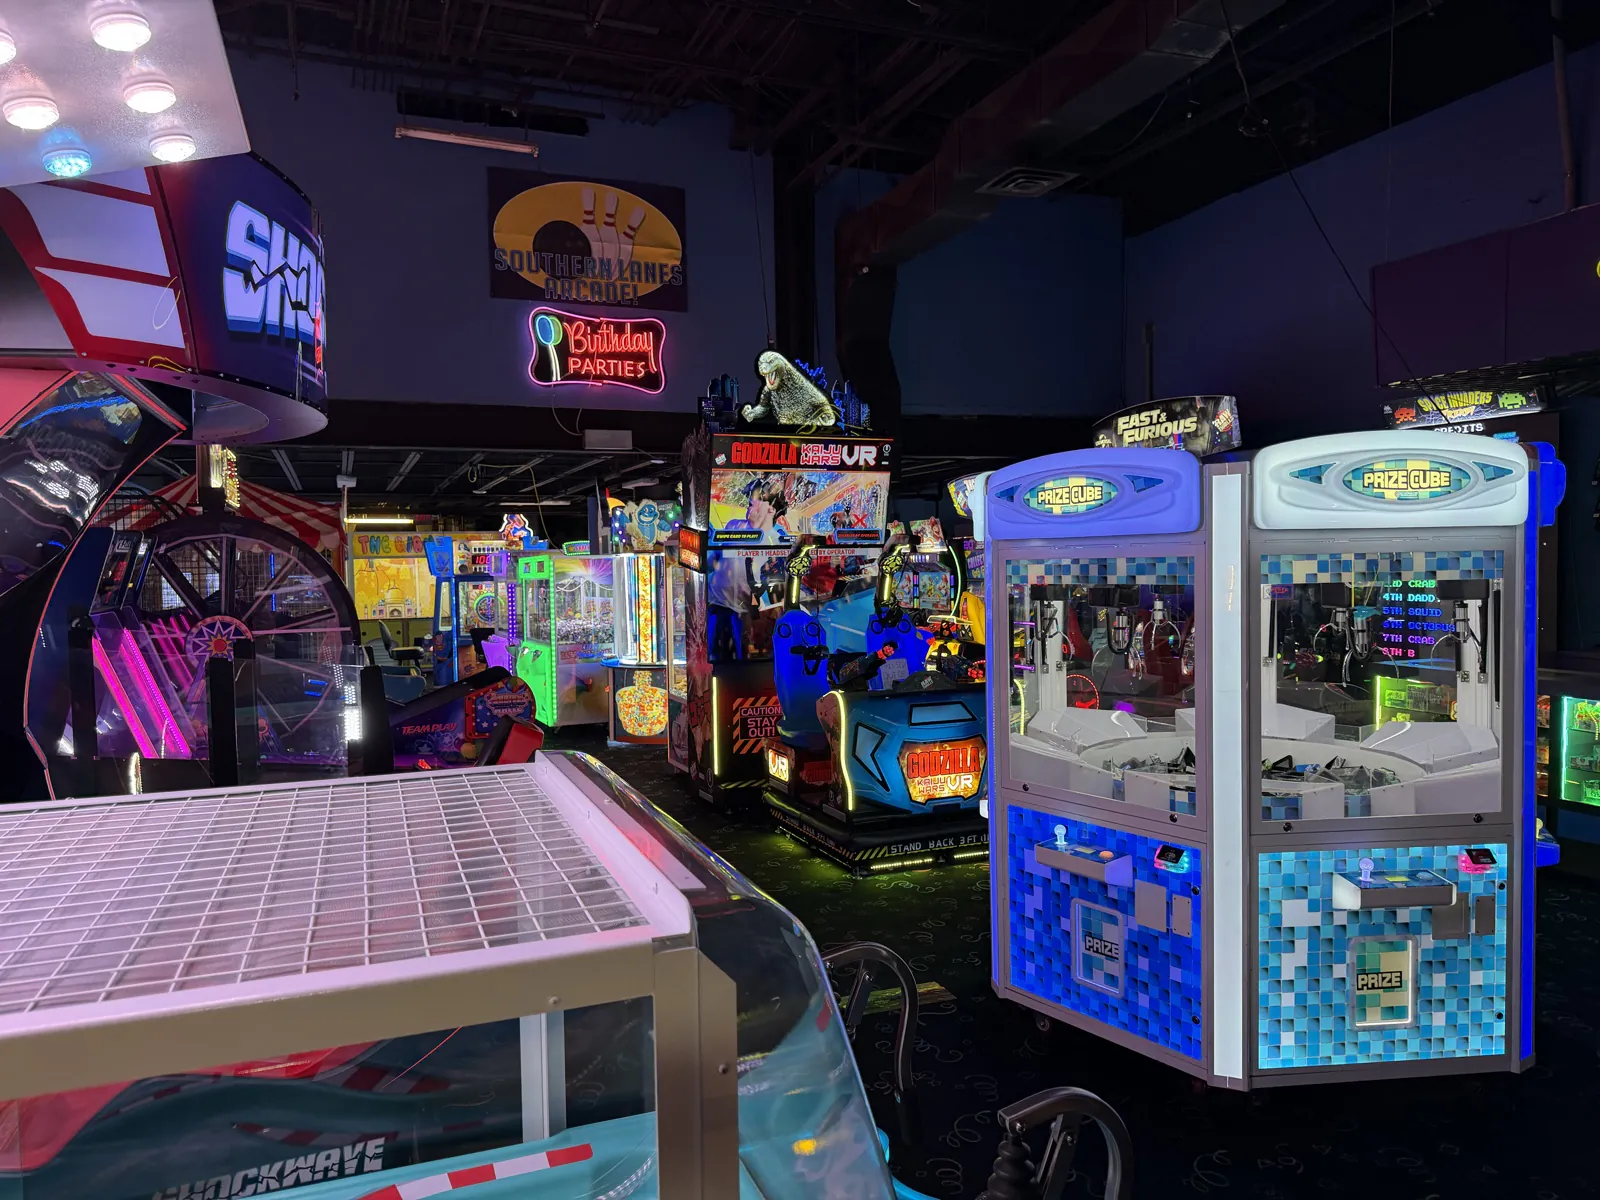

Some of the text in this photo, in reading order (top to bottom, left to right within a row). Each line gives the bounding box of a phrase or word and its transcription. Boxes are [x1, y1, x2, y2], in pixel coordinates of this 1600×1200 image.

[494, 248, 683, 286] SOUTHERN LANES
[545, 278, 639, 305] ARCADE!
[563, 320, 658, 373] Birthday
[569, 357, 646, 378] PARTIES
[1447, 391, 1493, 407] INVADERS
[1117, 409, 1161, 435] FAST
[1123, 416, 1198, 447] FURIOUS
[731, 441, 797, 465] GODZILLA
[842, 445, 877, 466] VR
[801, 443, 842, 455] KAIJU
[801, 455, 840, 465] WARS
[1364, 471, 1451, 489] PRIZE CUBE
[1038, 486, 1102, 504] PRIZE CUBE
[358, 535, 391, 554] THE
[1408, 580, 1436, 588] CRAB
[1383, 593, 1402, 601] 4TH
[1382, 606, 1442, 617] 5TH SQUID
[1408, 621, 1455, 632] OCTOPUS
[1382, 633, 1435, 645] 7TH CRAB
[402, 722, 458, 734] TEAM PLAY
[747, 717, 778, 728] STAY
[748, 727, 776, 737] OUT!
[769, 750, 788, 779] VR
[908, 747, 980, 779] GODZILLA
[917, 776, 946, 787] KAIJU
[918, 785, 945, 794] WARS
[947, 774, 973, 790] VR
[890, 842, 922, 855] STAND
[928, 837, 954, 849] BACK
[1086, 936, 1119, 956] PRIZE
[1357, 973, 1402, 989] PRIZE
